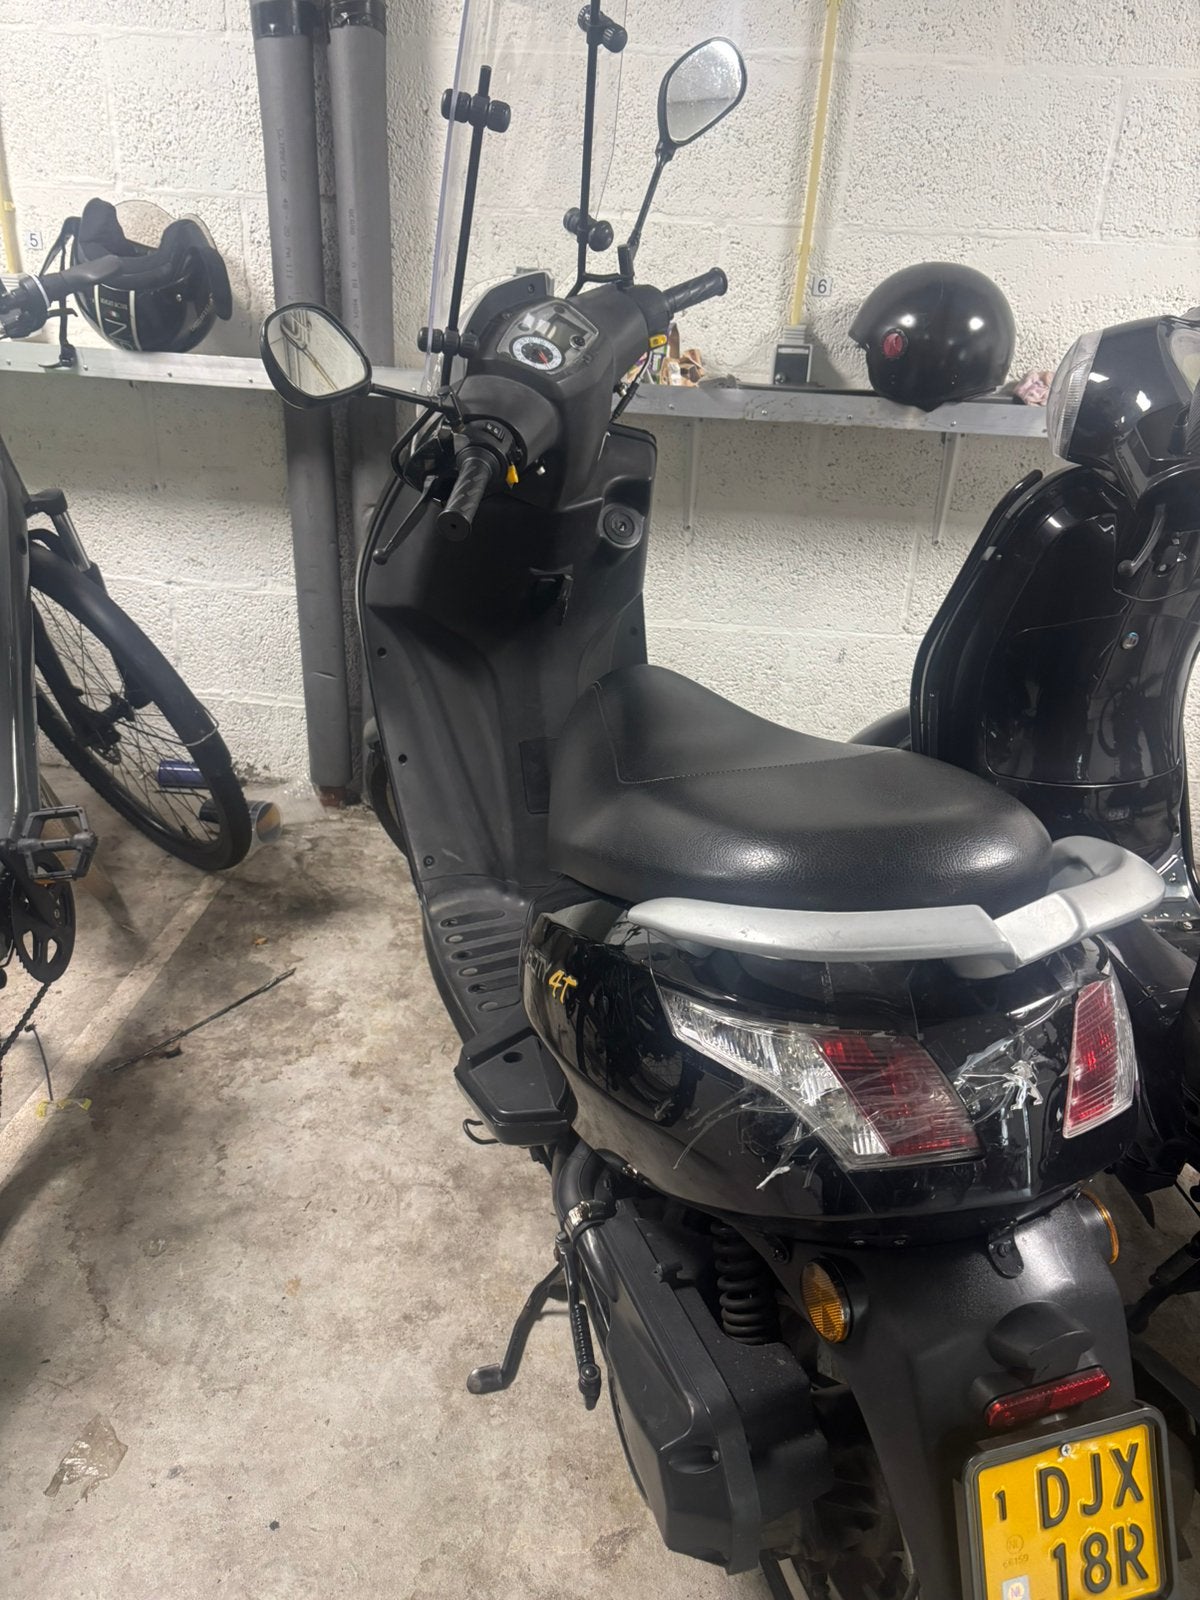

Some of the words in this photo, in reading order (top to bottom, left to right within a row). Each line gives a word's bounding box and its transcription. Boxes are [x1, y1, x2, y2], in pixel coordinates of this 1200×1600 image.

[30, 232, 38, 248] 5
[818, 278, 828, 294] 6
[548, 969, 578, 1005] 4T
[995, 1489, 1007, 1521] 1
[1038, 1442, 1144, 1530] DJX
[1052, 1522, 1149, 1600] 18R
